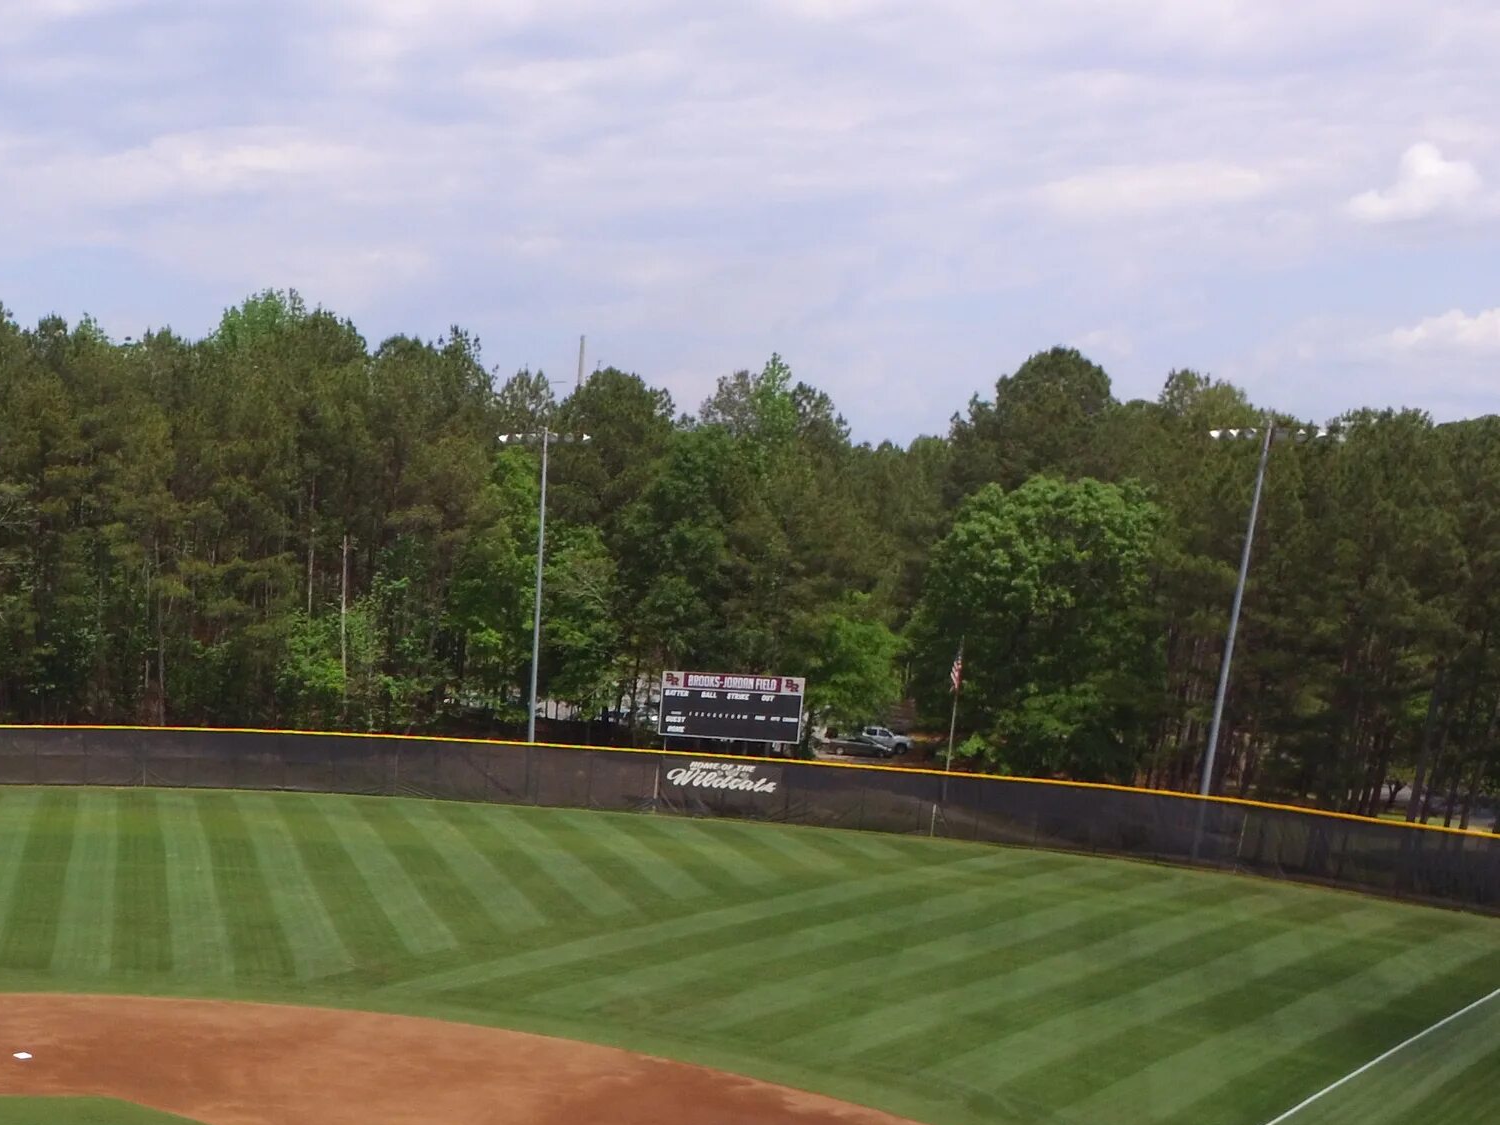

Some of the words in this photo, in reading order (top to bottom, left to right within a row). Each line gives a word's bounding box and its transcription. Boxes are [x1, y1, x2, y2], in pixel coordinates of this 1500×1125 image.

[688, 675, 754, 689] BROOKS-JORDAN
[755, 679, 777, 691] FIELD
[690, 761, 719, 770] HOME
[736, 765, 756, 773] THE
[666, 768, 776, 792] Wildcats
